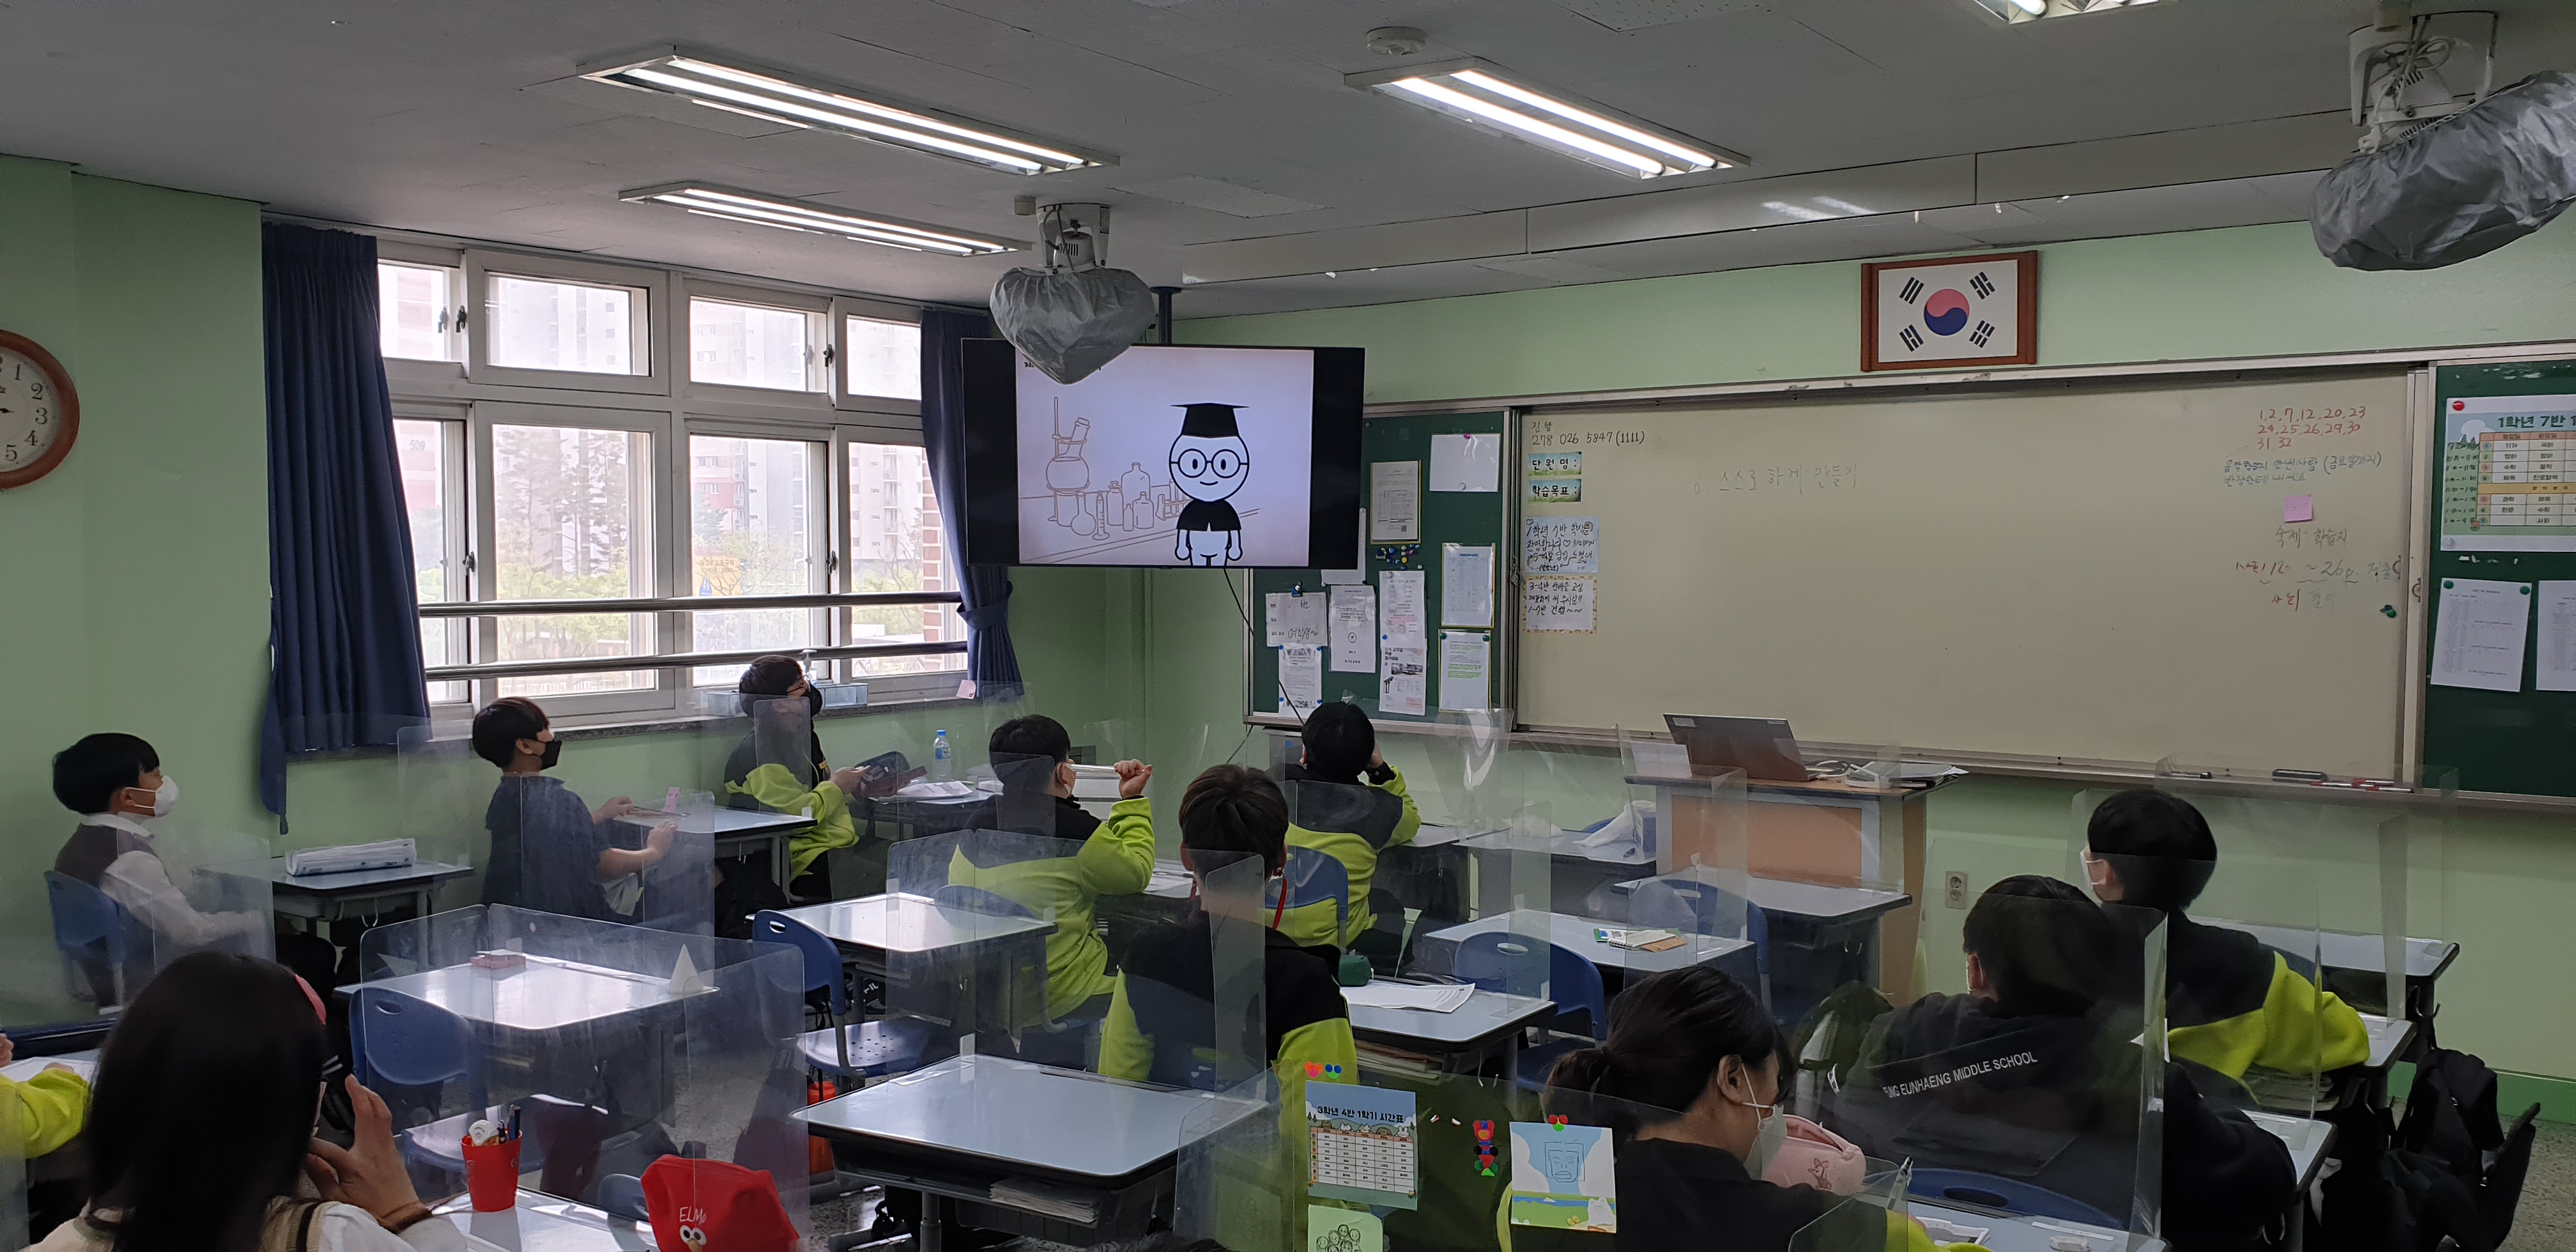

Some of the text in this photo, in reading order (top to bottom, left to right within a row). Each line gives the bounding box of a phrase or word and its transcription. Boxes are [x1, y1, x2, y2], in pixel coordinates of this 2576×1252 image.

[13, 363, 21, 381] 1
[31, 383, 43, 400] 2
[35, 407, 47, 424] 3
[2498, 415, 2534, 429] 1학년
[2540, 415, 2566, 428] 7반
[24, 430, 38, 446] 4
[410, 439, 426, 451] 509
[1531, 435, 1552, 447] 278
[1560, 432, 1579, 445] 026
[6, 444, 17, 461] 5
[1815, 464, 1856, 489] 만들기
[1532, 485, 1569, 498] 학습목표
[1900, 1073, 1951, 1096] EUNHAENG
[1952, 1060, 1992, 1081] MIDDLE
[1992, 1051, 2038, 1070] SCHOOL
[1317, 1106, 1404, 1123] 3학년 4반 1학기 시간표
